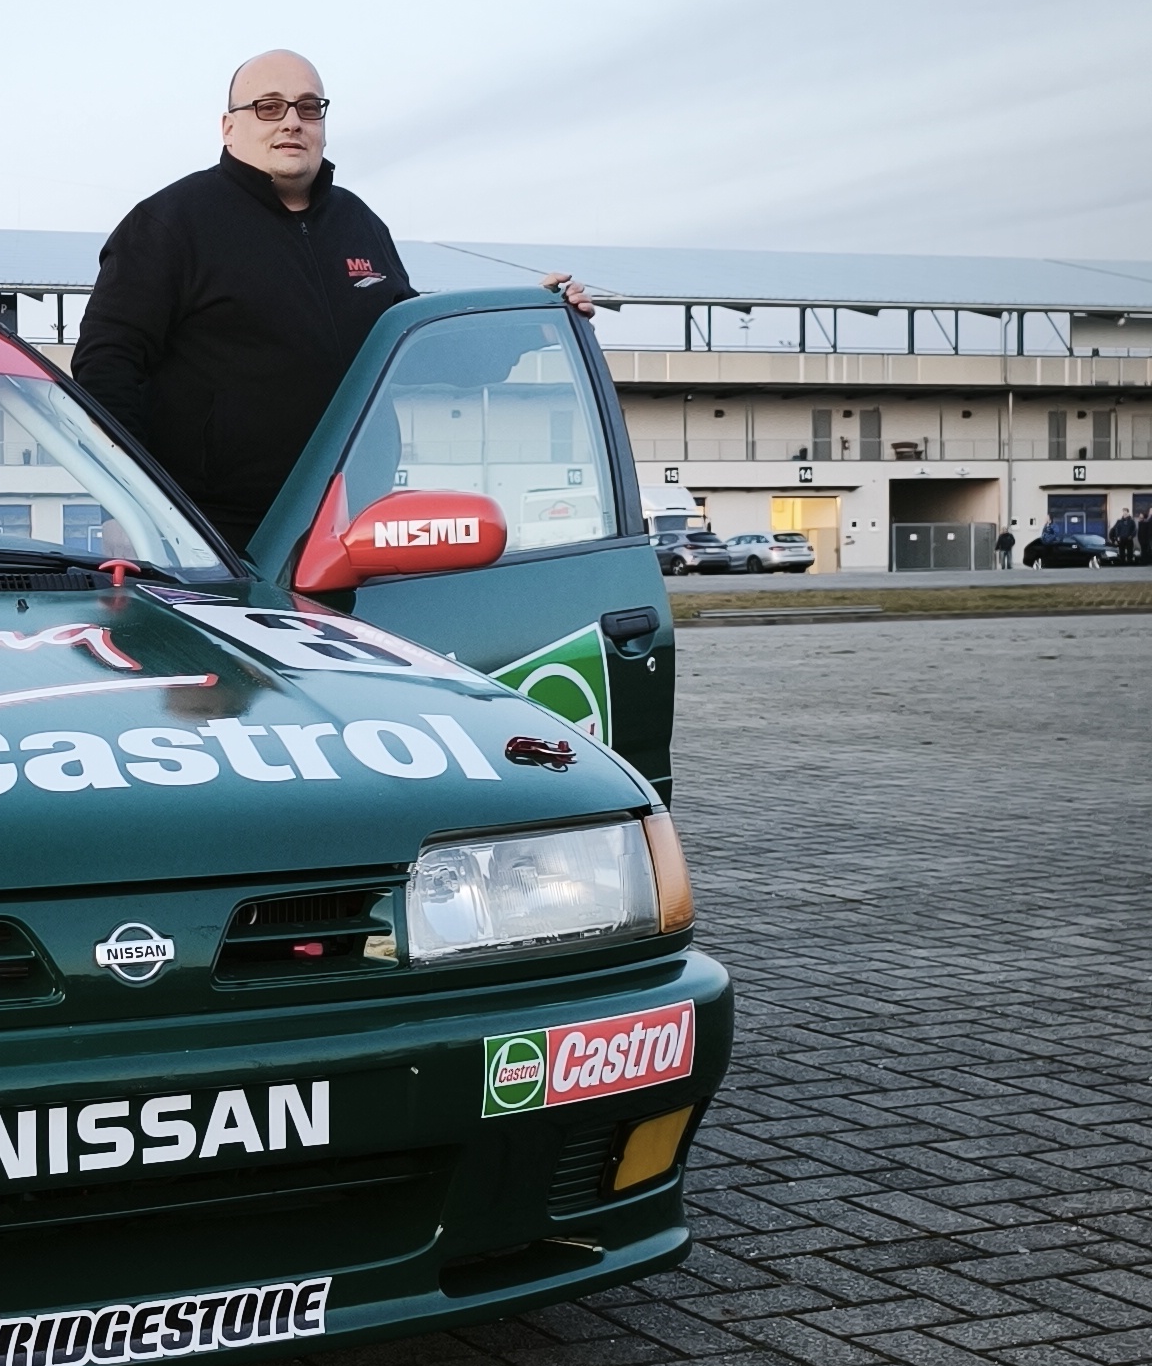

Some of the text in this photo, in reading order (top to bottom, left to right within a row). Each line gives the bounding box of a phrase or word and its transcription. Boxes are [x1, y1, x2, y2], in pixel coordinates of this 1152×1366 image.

[568, 470, 581, 484] 16
[665, 469, 679, 482] 15
[799, 468, 812, 480] 14
[374, 517, 480, 548] NISMO
[107, 944, 167, 961] NISSAN
[552, 1011, 691, 1093] Castrol
[498, 1062, 541, 1083] Castrol
